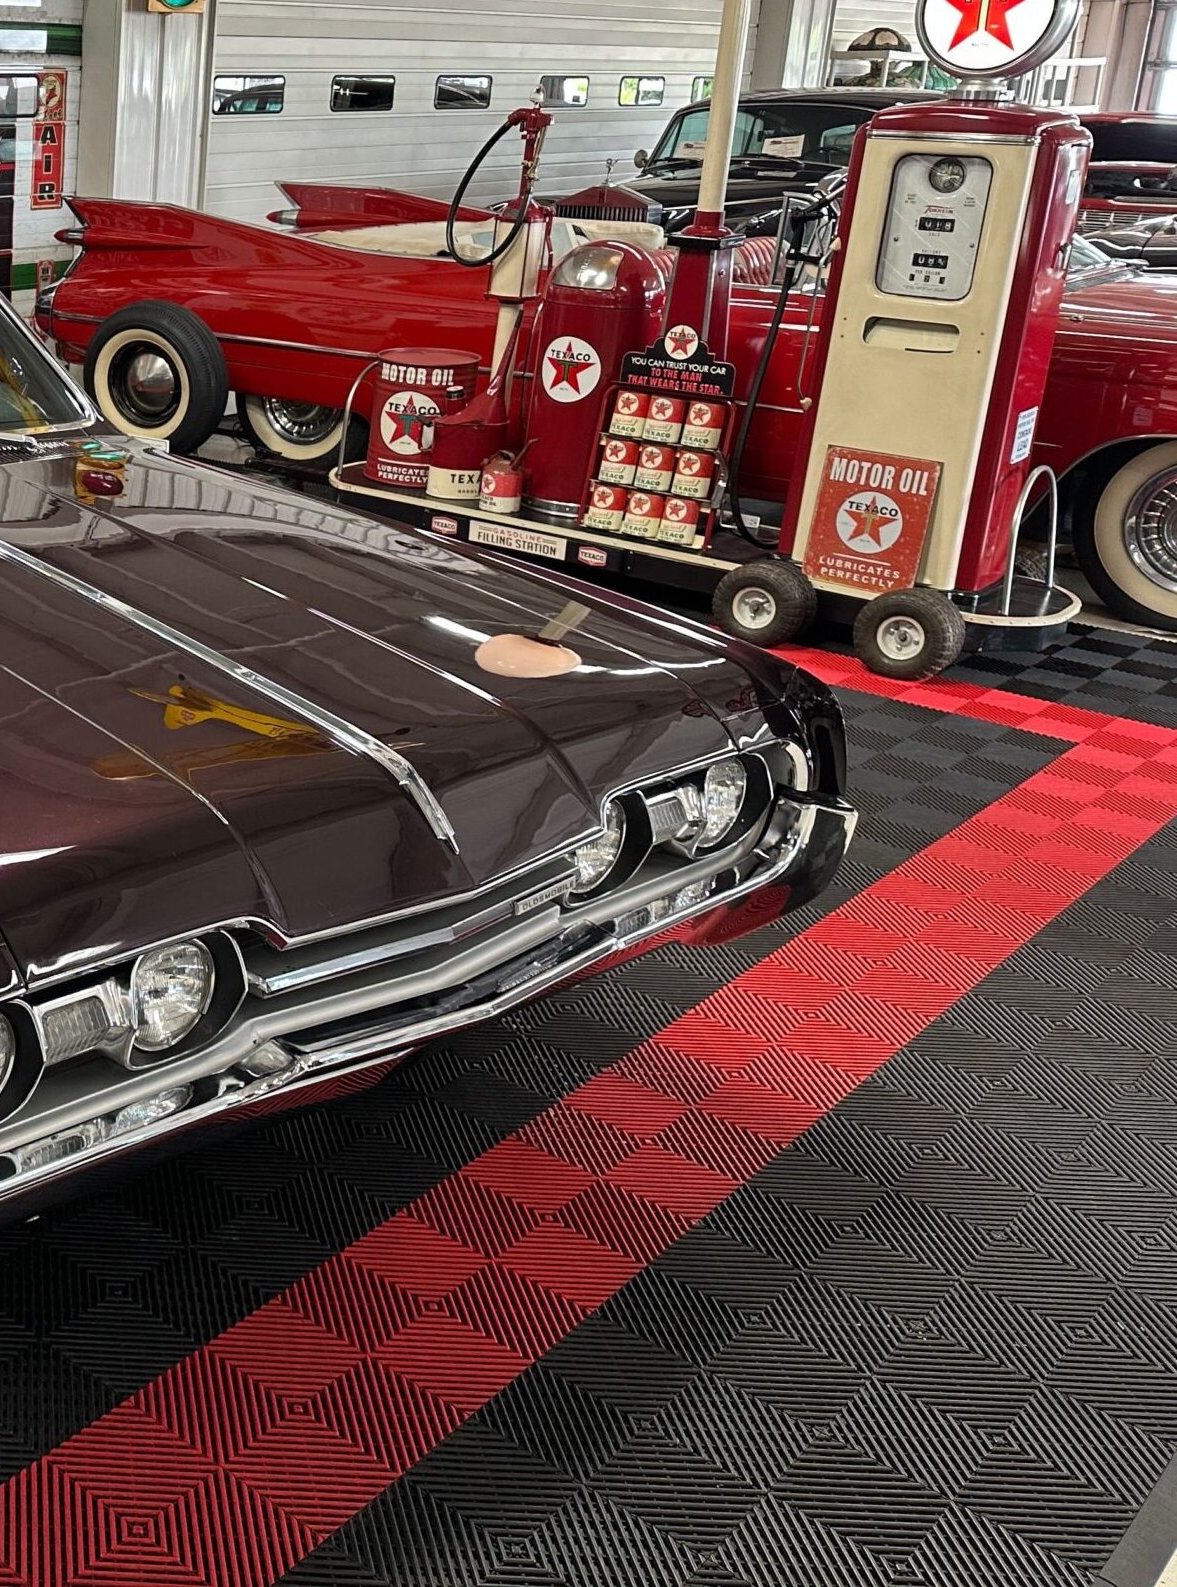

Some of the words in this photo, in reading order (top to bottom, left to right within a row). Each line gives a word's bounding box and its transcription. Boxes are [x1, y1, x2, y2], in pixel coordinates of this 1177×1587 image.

[551, 349, 591, 361] TEXACO
[381, 363, 427, 385] MOTOR
[432, 368, 454, 386] OIL
[631, 357, 647, 366] YOU
[648, 359, 665, 368] CAN
[666, 361, 687, 370] TRUST
[688, 363, 709, 373] YOUR
[710, 366, 727, 375] CAR
[627, 374, 648, 386] THAT
[649, 377, 680, 390] WEARS
[681, 381, 698, 392] THE
[651, 368, 661, 377] TO
[663, 369, 679, 379] THE
[680, 371, 703, 382] MAN
[389, 402, 437, 416] TEXACO
[378, 472, 429, 483] PERFECTLY
[829, 457, 896, 490] MOTOR
[899, 468, 929, 496] OIL
[848, 500, 898, 517] TEXACO
[434, 521, 456, 531] TEXACO
[493, 527, 542, 542] GASOLINE
[477, 531, 513, 547] FILLING
[515, 538, 557, 556] STATION
[581, 552, 605, 562] TEXACO
[819, 555, 901, 579] LUBRICATES
[820, 566, 895, 588] PERFECTLY
[522, 880, 575, 911] OLDSMOBILE
